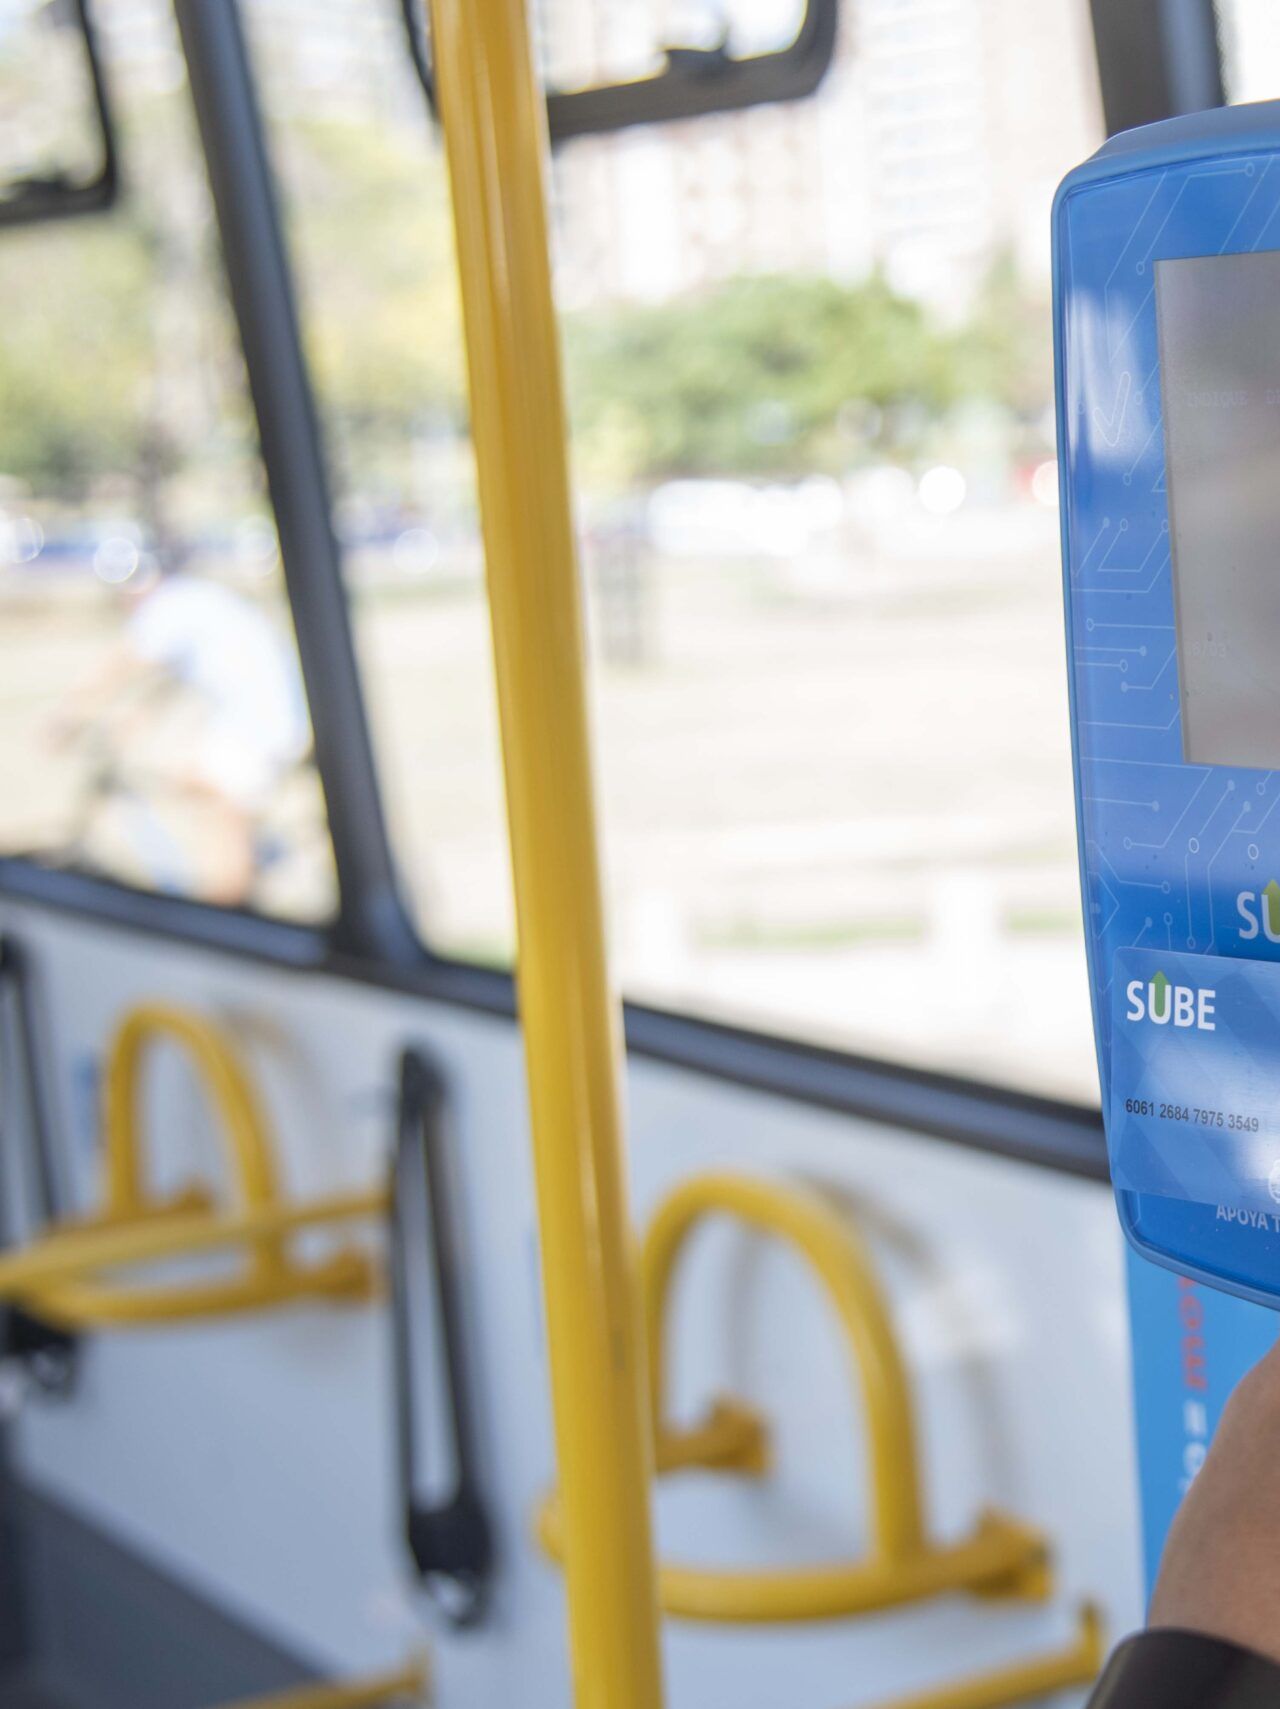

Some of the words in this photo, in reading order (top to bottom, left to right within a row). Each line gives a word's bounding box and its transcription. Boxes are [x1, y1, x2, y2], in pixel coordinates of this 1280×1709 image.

[1187, 390, 1247, 408] INDIQUE
[1126, 971, 1216, 1031] SUBE
[1125, 1098, 1154, 1117] 6061
[1159, 1103, 1189, 1122] 2684
[1193, 1108, 1224, 1128] 7975
[1228, 1114, 1259, 1133] 3549
[1216, 1204, 1269, 1231] APOYA
